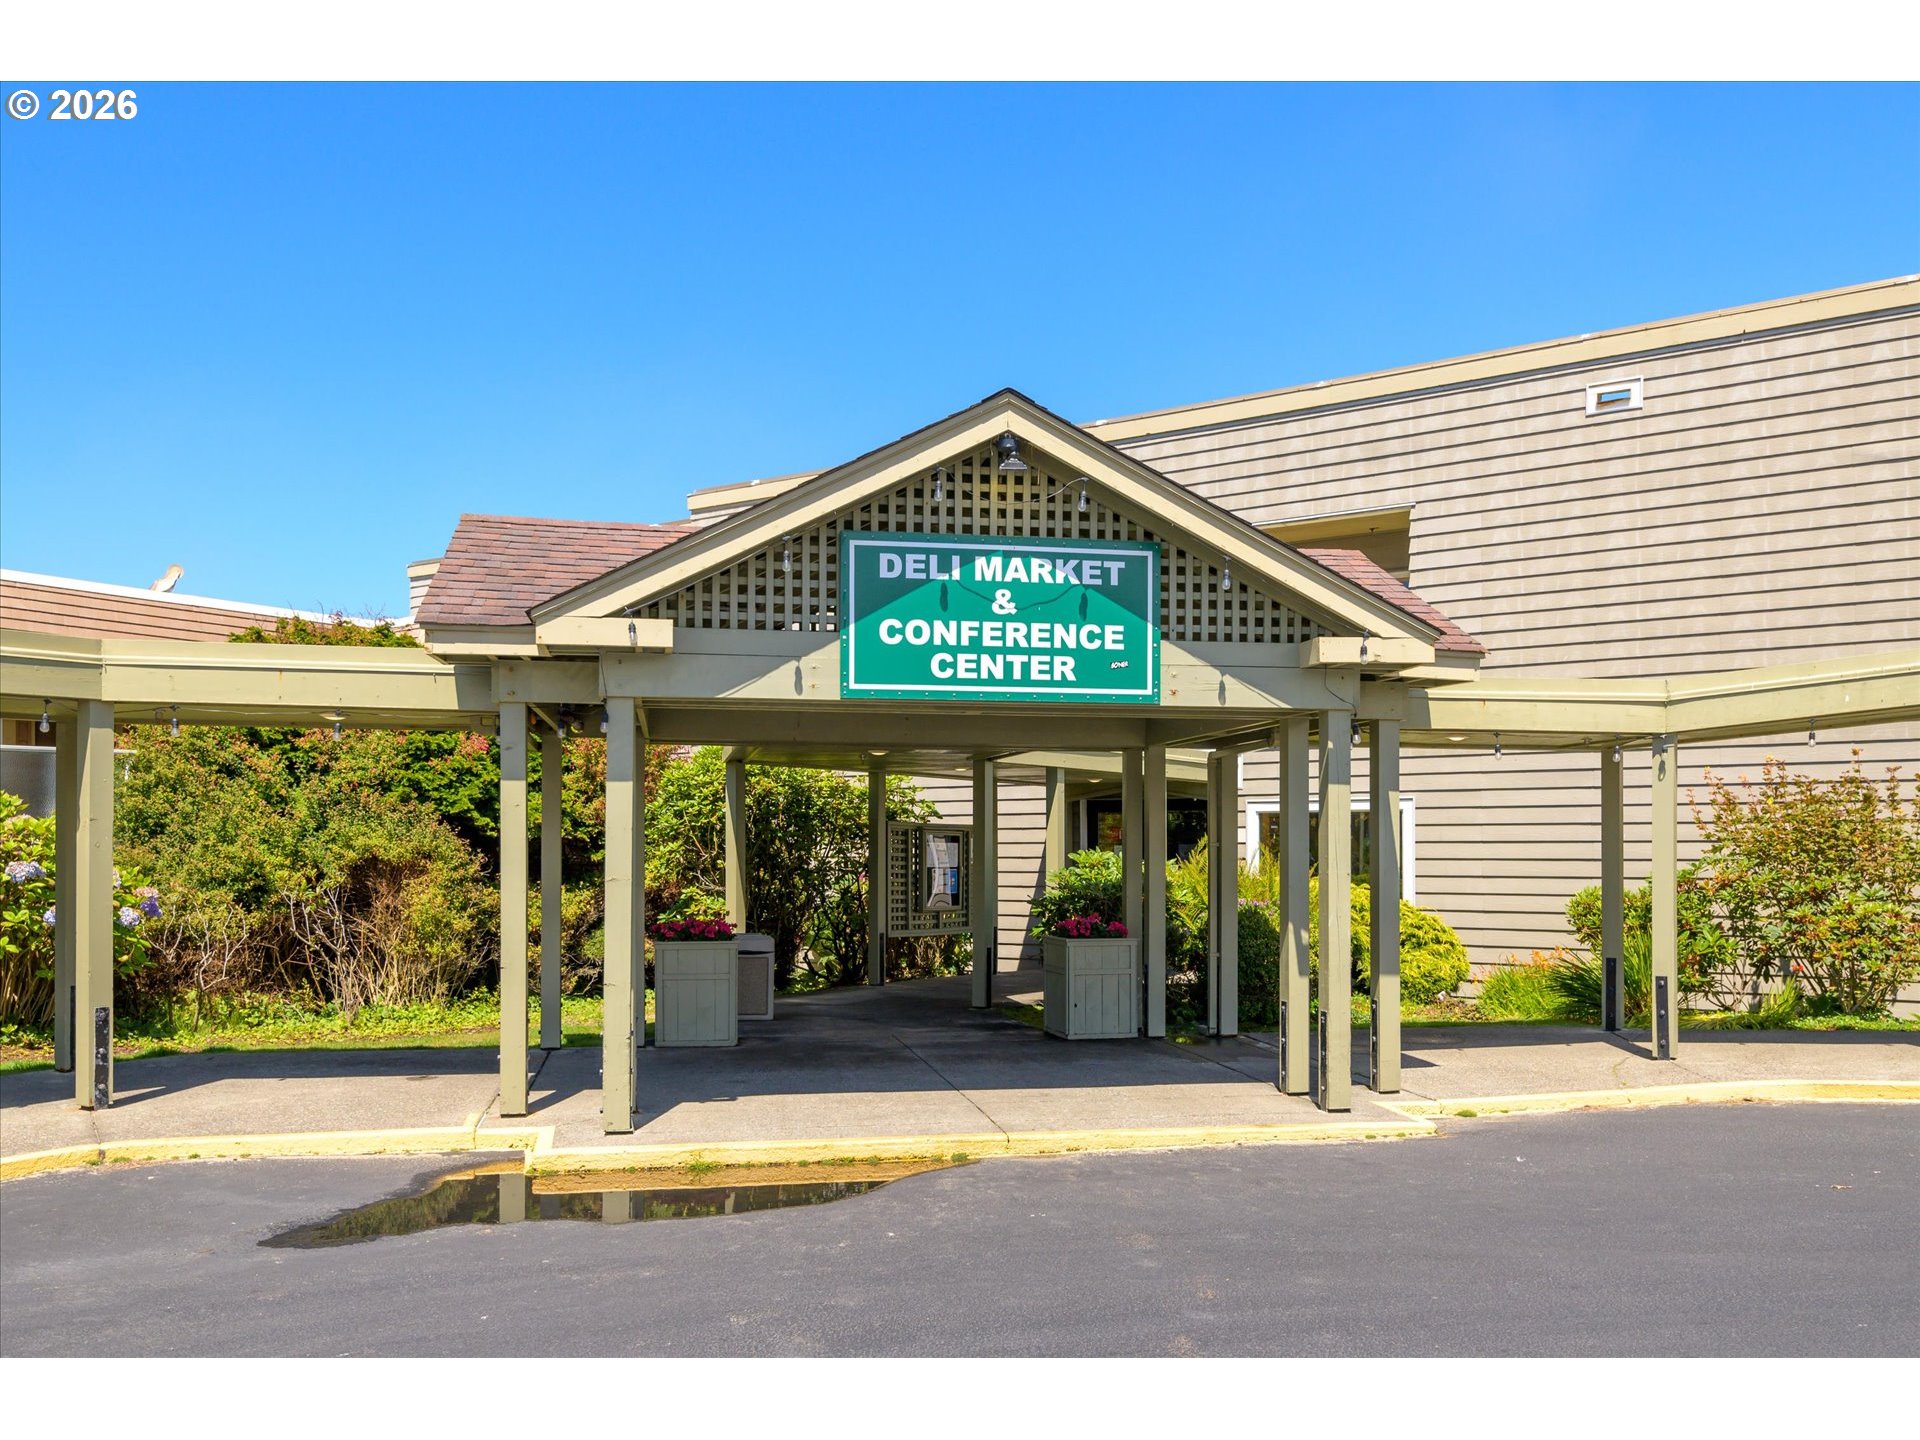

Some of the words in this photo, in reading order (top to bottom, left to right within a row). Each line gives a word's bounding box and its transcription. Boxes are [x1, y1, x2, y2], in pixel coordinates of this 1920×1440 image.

[879, 552, 960, 581] DELI
[974, 556, 1126, 586] MARKET
[991, 588, 1017, 615] &
[878, 618, 1125, 650] CONFERENCE
[930, 652, 1077, 681] CENTER
